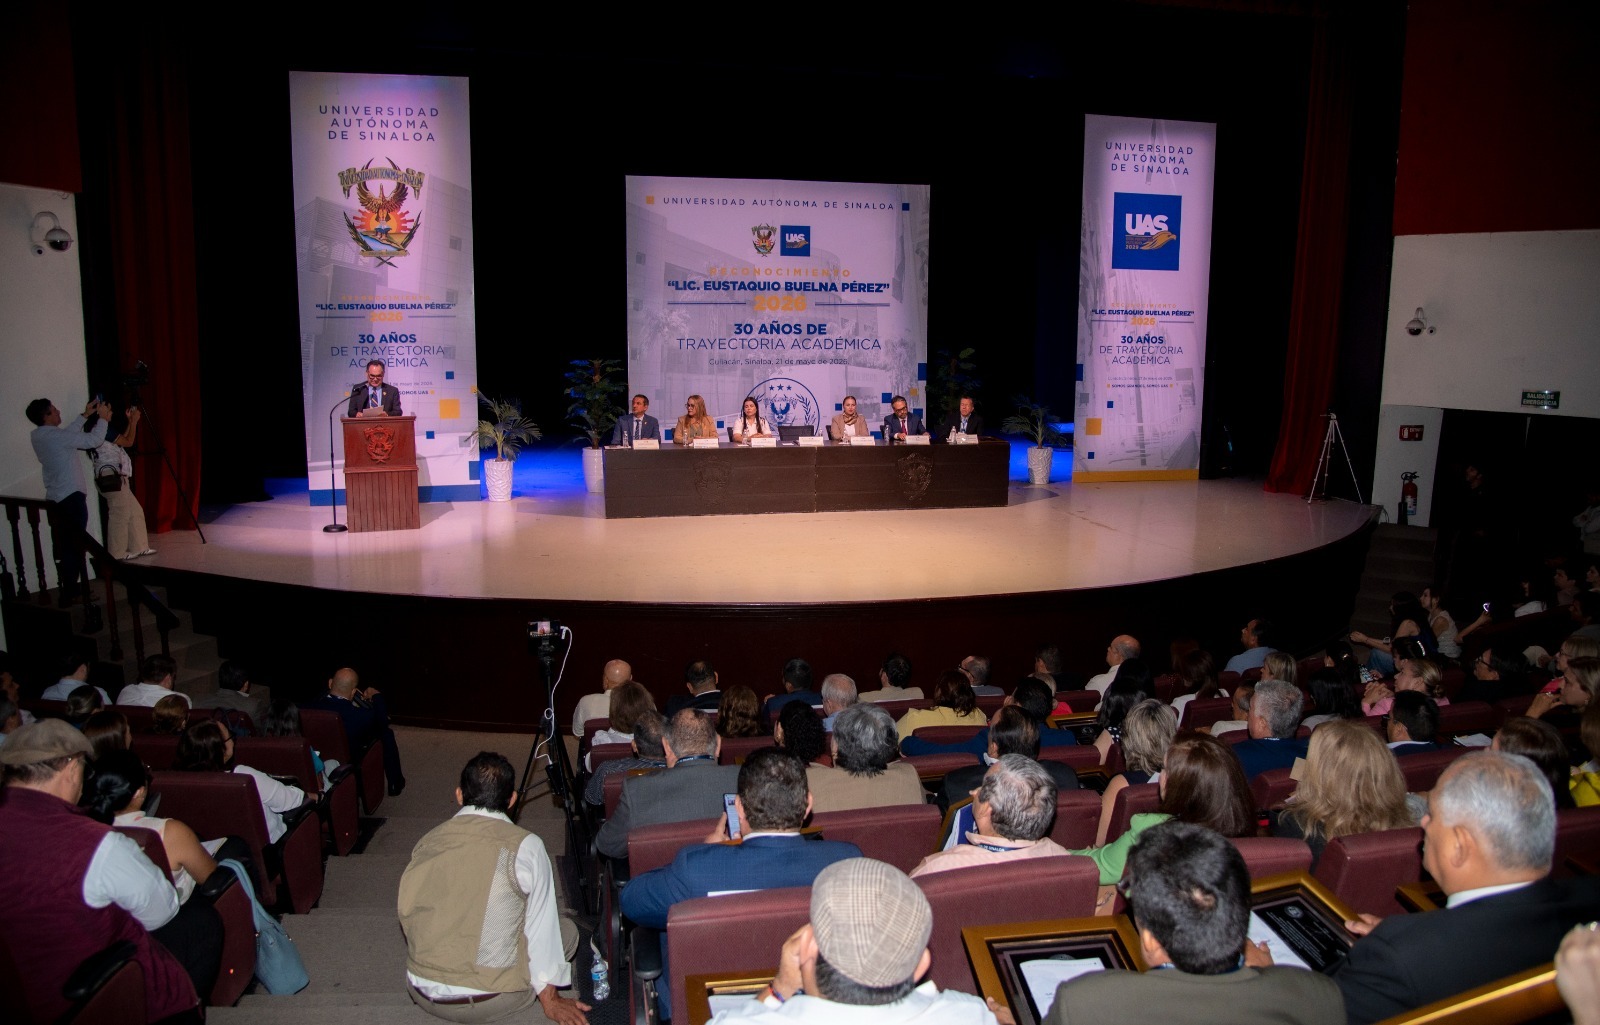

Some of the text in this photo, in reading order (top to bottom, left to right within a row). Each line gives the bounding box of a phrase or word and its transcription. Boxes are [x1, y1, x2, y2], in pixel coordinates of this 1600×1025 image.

[319, 105, 439, 117] UNIVERSIDAD
[331, 116, 429, 129] AUTÓNOMA
[328, 130, 436, 142] DE SINALOA
[1105, 142, 1194, 154] UNIVERSIDAD
[1113, 153, 1185, 165] AUTÓNOMA
[1111, 163, 1189, 176] DE SINALOA
[663, 197, 745, 206] UNIVERSIDAD
[752, 198, 818, 208] AUTÓNOMA
[844, 202, 894, 210] SINALOA
[1125, 213, 1168, 236] UAS
[786, 233, 806, 242] UAS
[710, 267, 850, 278] RECONOCIMIENTO
[703, 280, 781, 292] EUSTAQUIO
[784, 281, 838, 292] BUELNA
[753, 295, 807, 312] 2026
[370, 311, 403, 323] 2026
[1130, 317, 1156, 326] 2026
[734, 320, 827, 335] 30 AÑOS DE
[358, 332, 417, 344] 30 AÑOS
[676, 336, 882, 350] TRAYECTORIA ACADÉMICA
[1120, 334, 1164, 344] 30 AÑOS
[330, 346, 446, 357] DE TRAYECTORIA
[1100, 345, 1184, 355] DE TRAYECTORIA
[348, 356, 429, 368] ACÉMICA
[1112, 354, 1171, 365] ACADÉMICA
